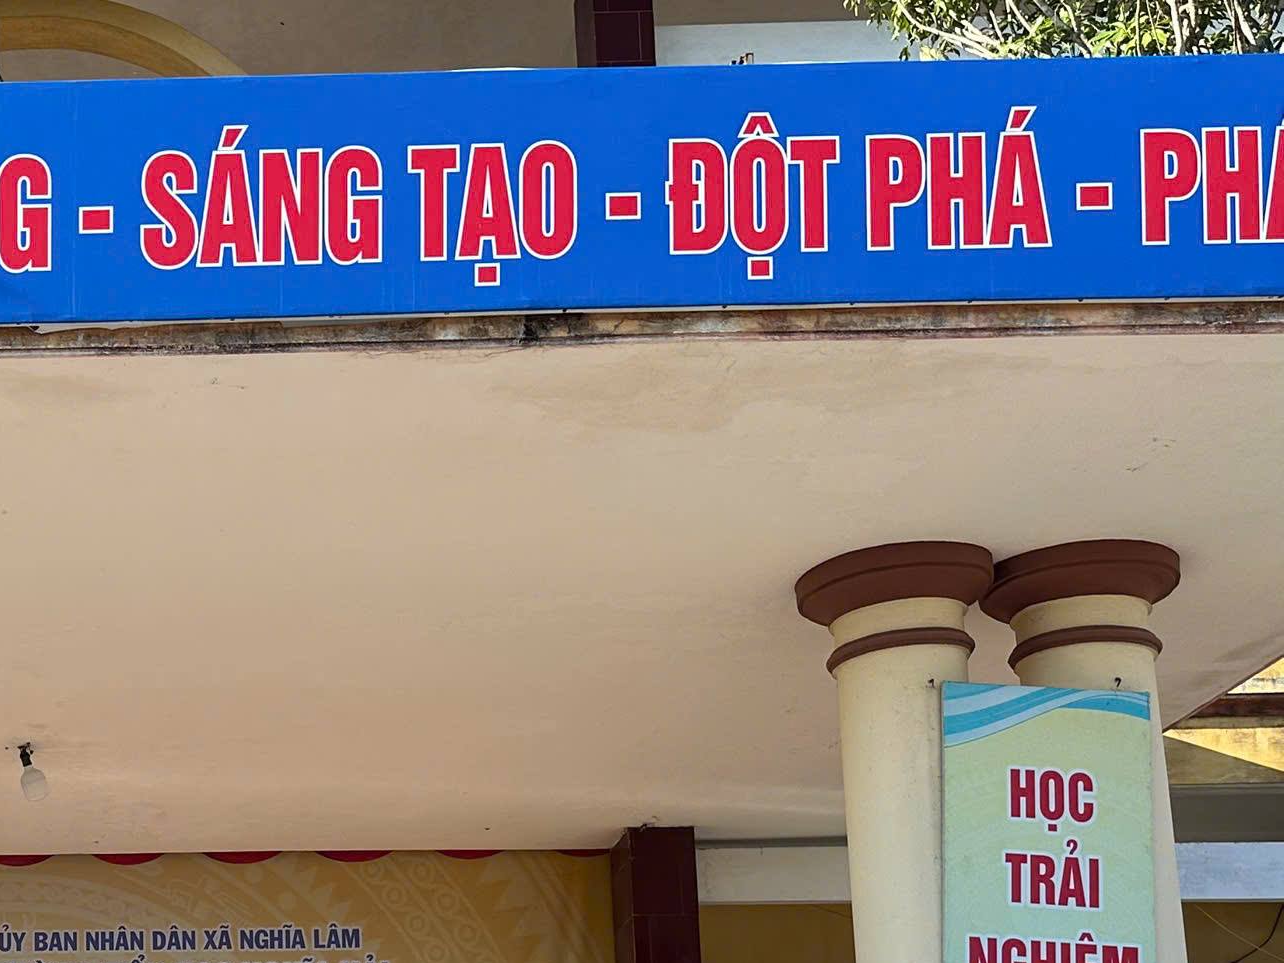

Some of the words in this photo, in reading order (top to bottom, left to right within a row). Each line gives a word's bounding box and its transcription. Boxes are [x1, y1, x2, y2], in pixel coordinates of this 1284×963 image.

[140, 124, 383, 270] SÁNG
[407, 139, 578, 287] TẠO
[665, 111, 841, 281] ĐỘT
[865, 105, 1052, 252] PHÁ
[1009, 766, 1095, 833] HỌC
[1005, 838, 1101, 909] TRẢI
[34, 931, 77, 951] BAN
[85, 925, 144, 951] NHÂN
[152, 925, 196, 950] DÂN
[203, 925, 232, 950] XÃ
[239, 923, 306, 950] NGHĨA
[313, 923, 361, 949] LÂM
